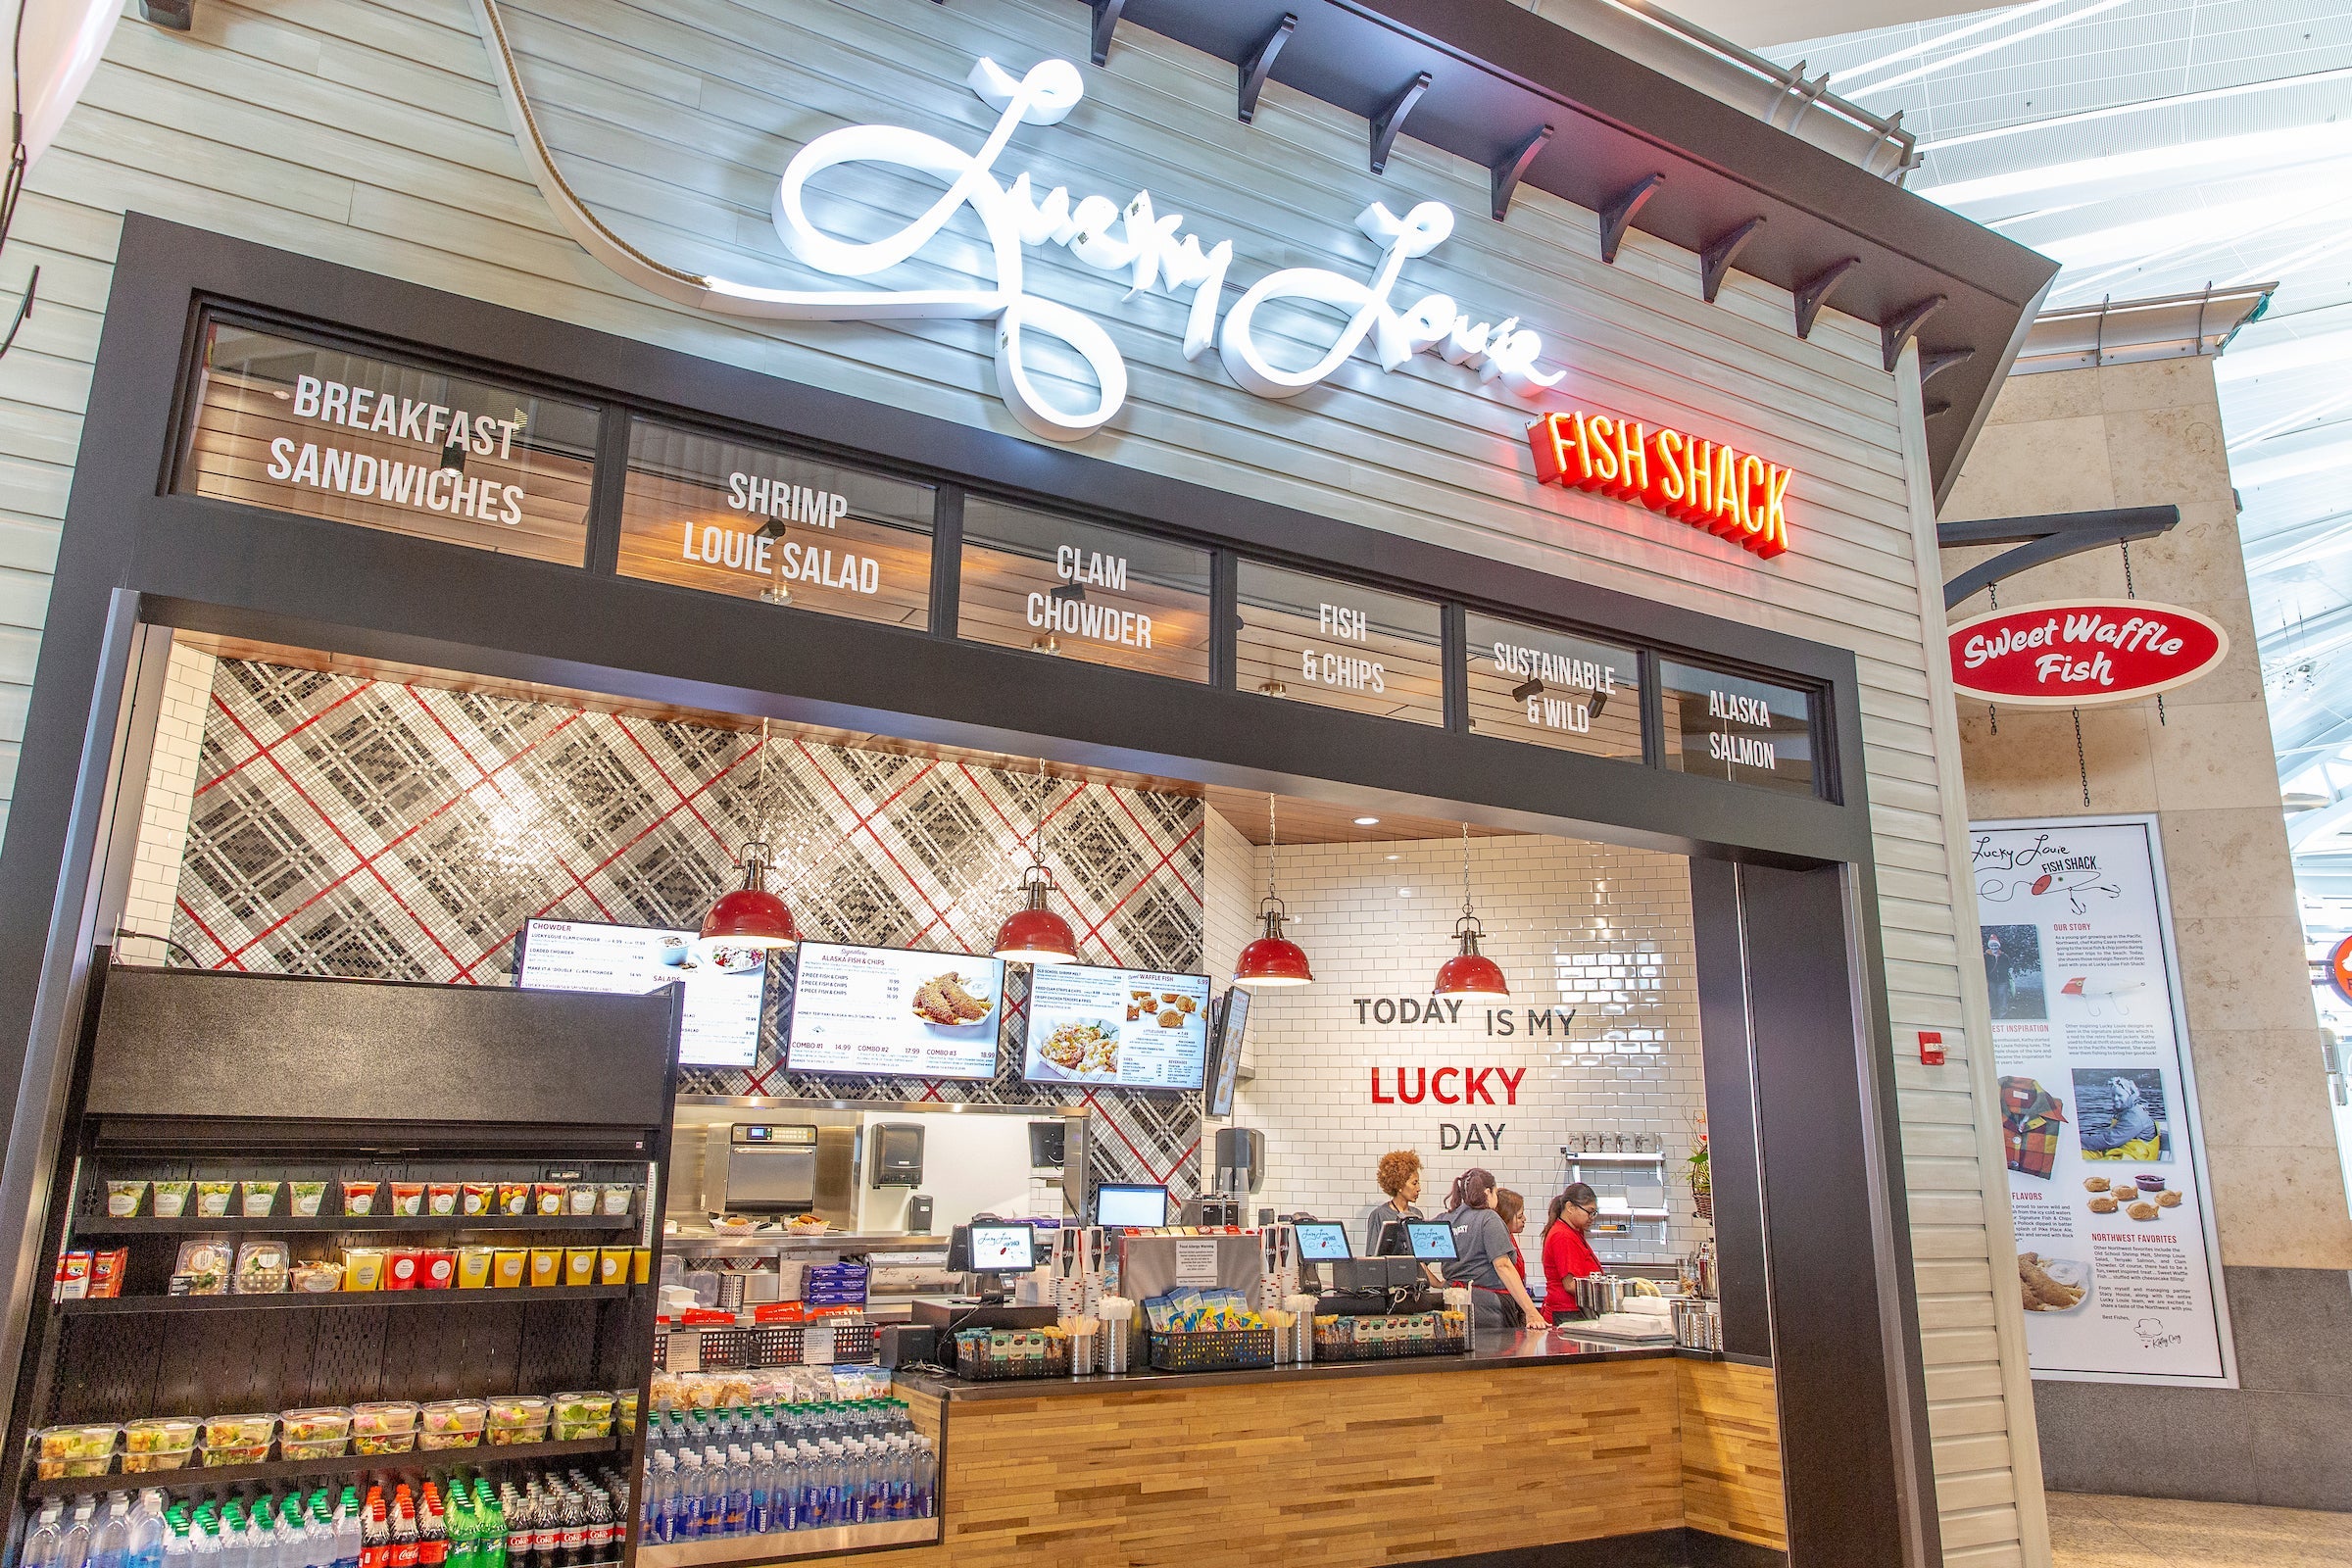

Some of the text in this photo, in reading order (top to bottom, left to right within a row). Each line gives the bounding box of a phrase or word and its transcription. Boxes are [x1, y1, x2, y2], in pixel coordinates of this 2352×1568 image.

[771, 59, 1567, 441] Lucky Louie
[293, 374, 519, 461] BREAKFAST
[267, 436, 524, 526] SANDWICHES
[727, 471, 849, 530] SHRIMP
[1542, 412, 1791, 557] FISH SHACK
[682, 520, 880, 596] LOUIE SALAD
[1056, 544, 1127, 592] CLAM
[1026, 592, 1152, 650] CHOWDER
[1319, 602, 1367, 643] FISH
[1964, 613, 2184, 669] Sweet Waffle
[1302, 649, 1385, 694] & CHIPS
[1493, 642, 1617, 696] SUSTAINABLE
[2034, 652, 2115, 686] Fish
[1527, 695, 1590, 734] & WILD
[1708, 689, 1771, 729] ALASKA
[1709, 731, 1776, 770] SALMON
[2016, 834, 2070, 866] Louie
[2041, 856, 2097, 873] FISH SHACK
[532, 922, 571, 932] CHOWDER
[2053, 923, 2068, 932] OUR
[1353, 998, 1577, 1036] TODAY IS MY
[2006, 1024, 2049, 1033] INSPIRATION
[792, 1041, 815, 1050] COMBO
[1371, 1067, 1526, 1104] LUCKY
[1441, 1124, 1506, 1151] DAY
[2012, 1192, 2043, 1200] FLAVORS
[2092, 1233, 2178, 1244] NORTHWEST FAVORITES
[590, 1531, 608, 1540] Coke
[665, 1517, 674, 1543] smart
